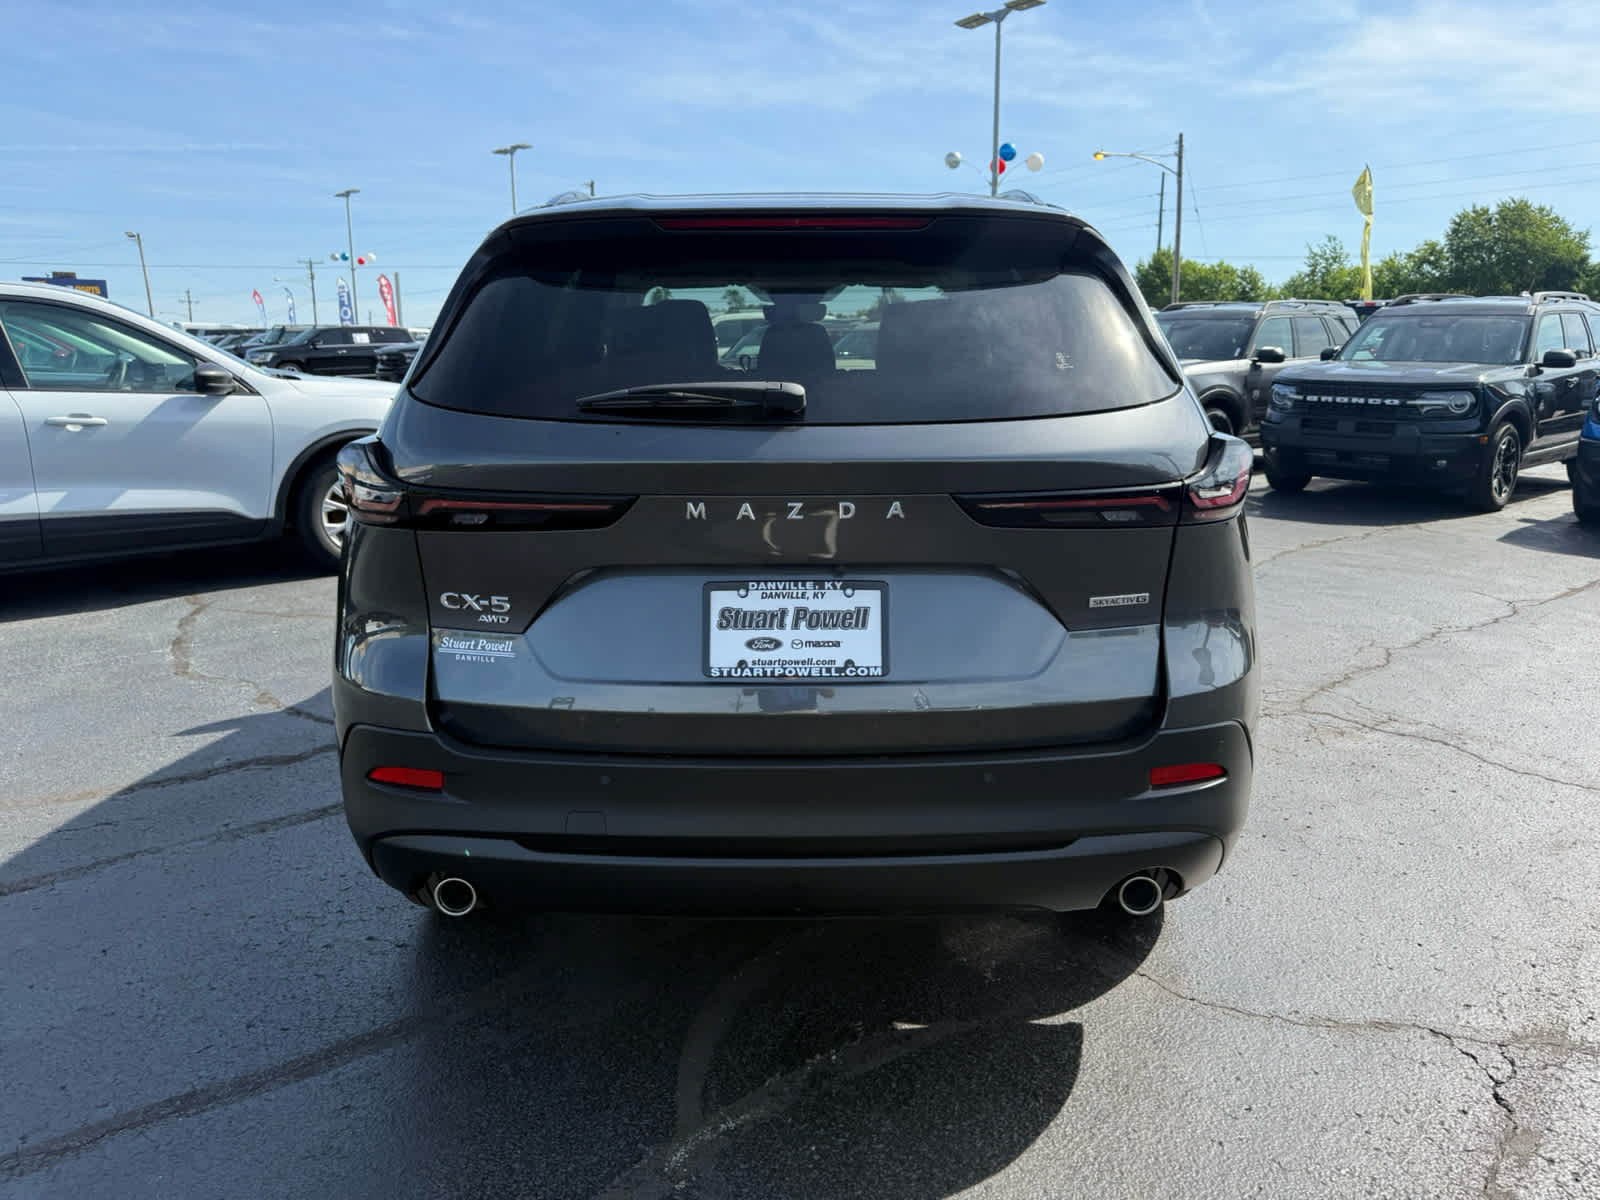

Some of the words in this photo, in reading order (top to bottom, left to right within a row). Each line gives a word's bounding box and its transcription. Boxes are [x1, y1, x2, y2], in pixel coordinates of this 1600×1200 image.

[1306, 395, 1400, 405] BRONCO
[685, 501, 905, 521] MAZDA
[824, 581, 843, 590] KY
[760, 592, 809, 601] DANVILLE,
[812, 591, 827, 600] KY
[440, 592, 511, 613] CX-5
[479, 614, 510, 624] AWD
[717, 607, 788, 630] Stuart
[791, 606, 870, 630] Powell
[441, 637, 475, 649] Stuart
[477, 640, 513, 652] Powell
[804, 640, 841, 648] mazda
[455, 654, 496, 663] DANVILLE
[751, 658, 836, 667] stuartpowell.com
[710, 667, 882, 676] STUARTPOWELL.COM
